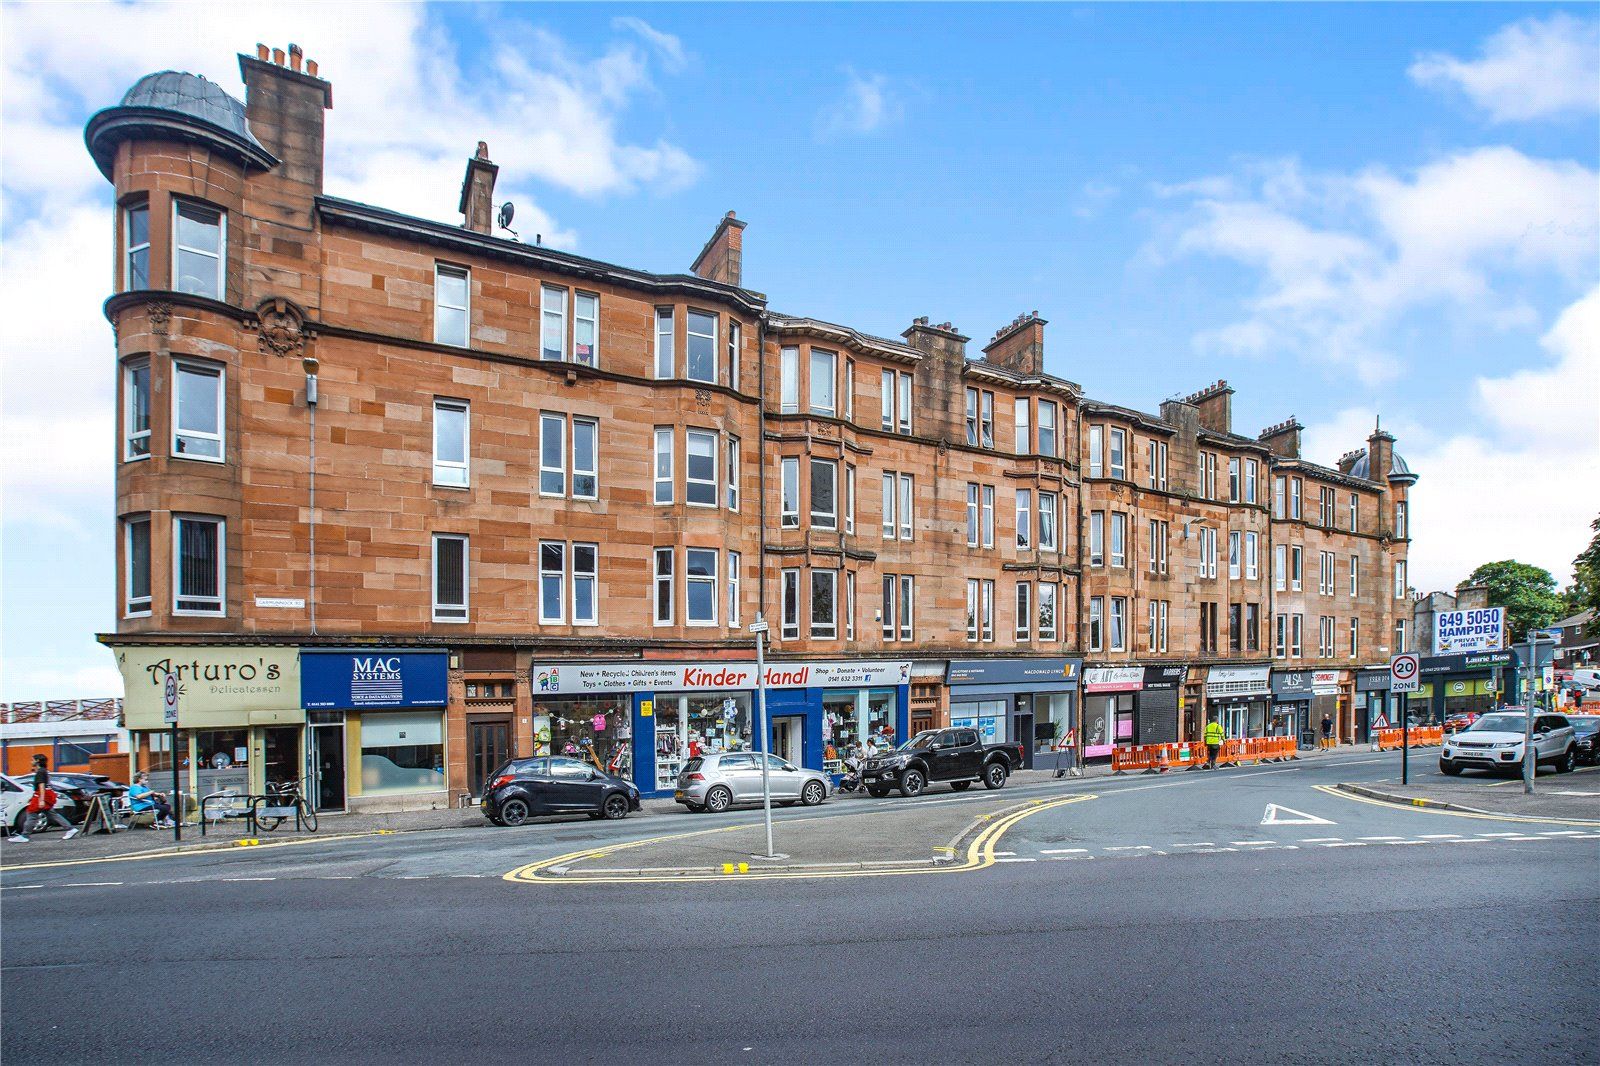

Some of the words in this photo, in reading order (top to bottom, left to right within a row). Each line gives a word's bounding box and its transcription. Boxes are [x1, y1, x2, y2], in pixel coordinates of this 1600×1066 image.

[1439, 612, 1463, 627] 649
[1467, 609, 1499, 625] 5050
[1439, 624, 1499, 637] HAMPDEN
[1465, 655, 1490, 664] Laurie
[1491, 653, 1511, 662] Ross
[352, 657, 401, 673] MAC
[1396, 662, 1414, 673] 20
[146, 658, 281, 685] Arturo's
[353, 672, 401, 680] SYSTEMS
[580, 670, 594, 678] New
[660, 669, 677, 677] items
[683, 668, 747, 687] Kinder
[209, 684, 281, 694] Delicatessen
[583, 680, 596, 688] Toys
[632, 679, 647, 687] Gifts
[1393, 681, 1416, 690] ZONE
[167, 684, 174, 697] 20
[166, 710, 177, 718] ZONE
